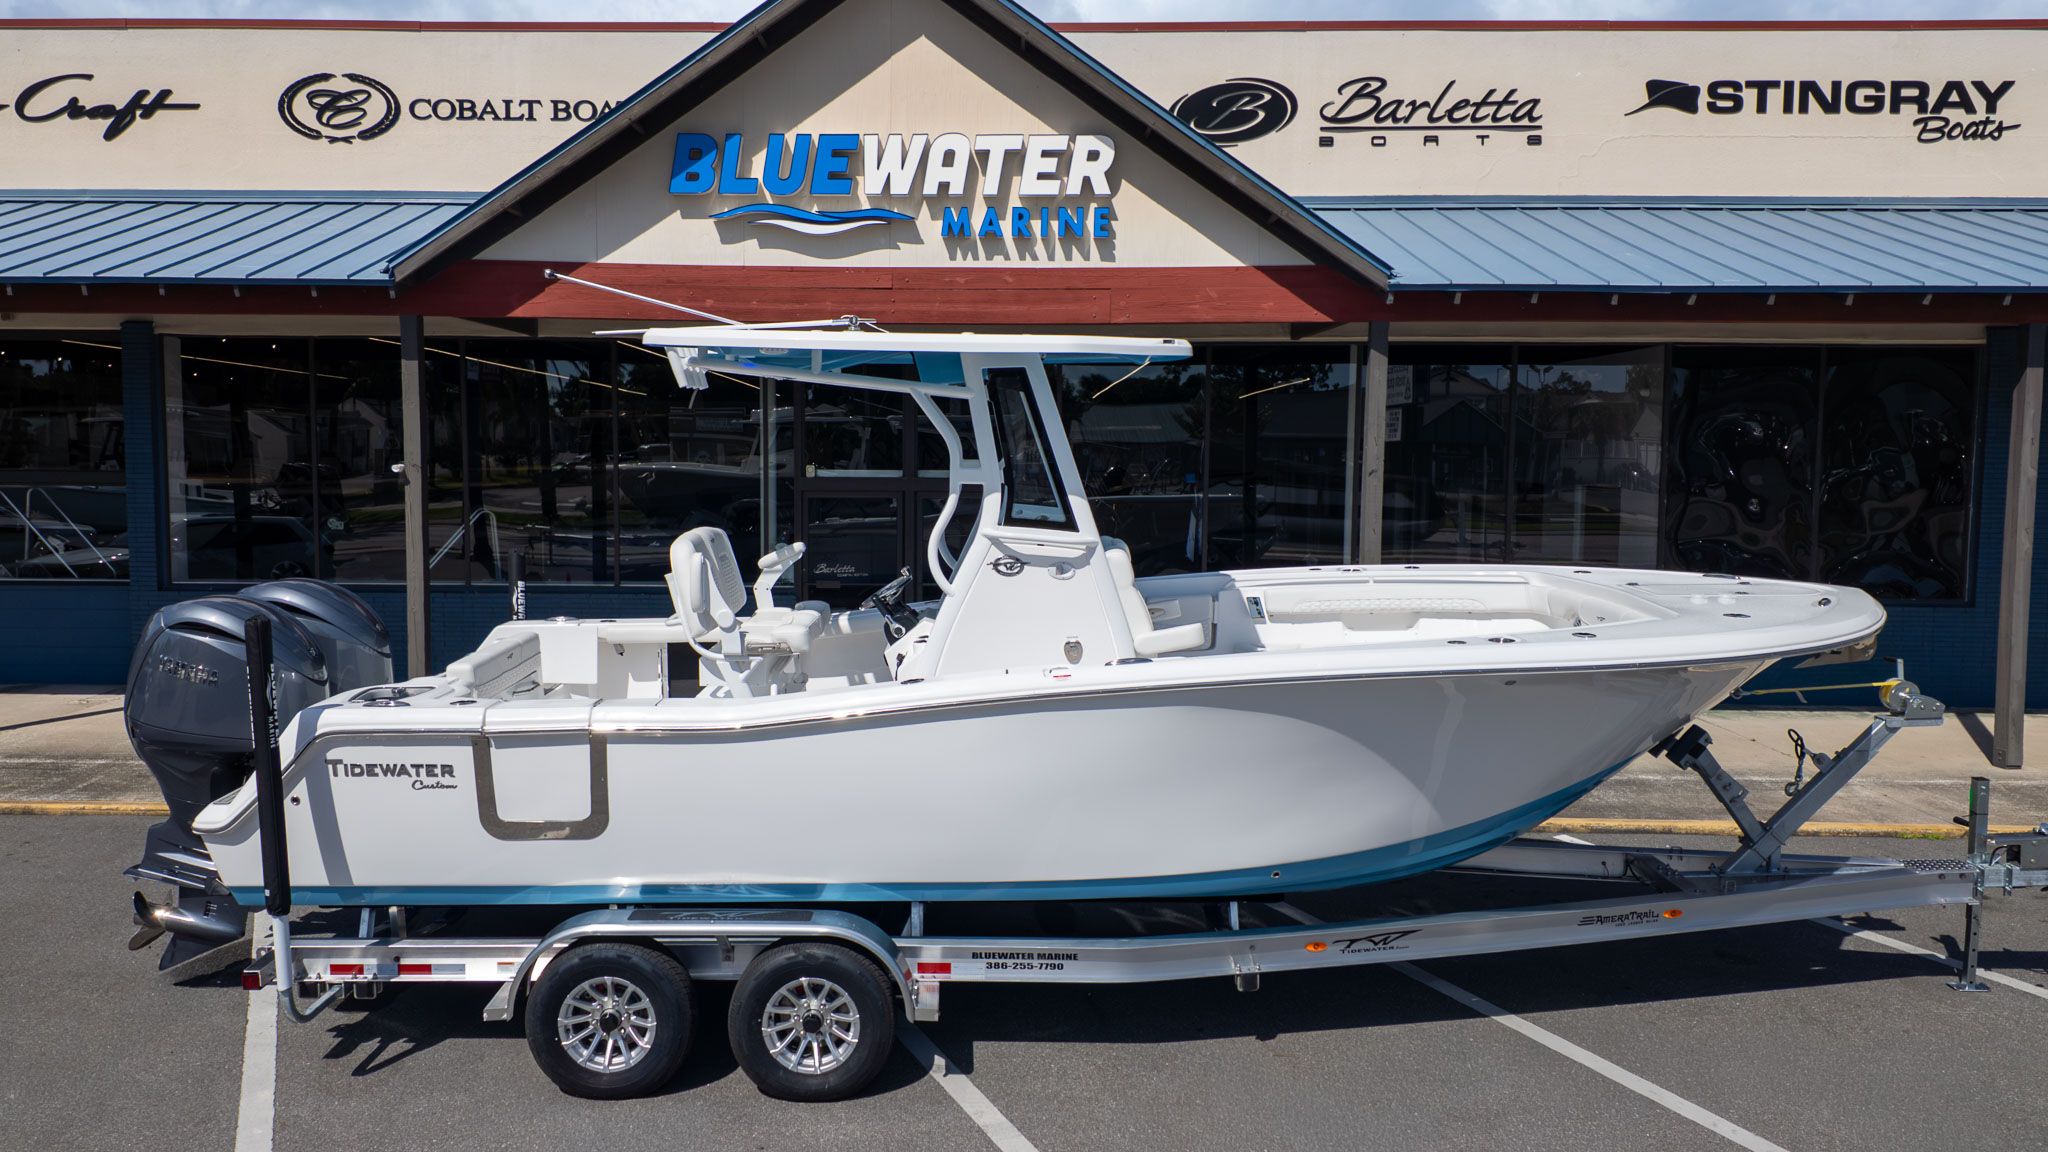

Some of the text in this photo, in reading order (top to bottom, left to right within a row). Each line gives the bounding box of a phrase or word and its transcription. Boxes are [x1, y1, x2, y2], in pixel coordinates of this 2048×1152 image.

[14, 73, 201, 142] Craft
[1319, 76, 1543, 124] Barletta
[1706, 80, 2016, 115] STINGRAY
[408, 98, 624, 122] COBALT BOA
[1318, 134, 1543, 147] BOATS
[1913, 115, 2022, 144] Boats
[668, 132, 1118, 197] BLUEWATER
[941, 206, 1111, 238] MARINE
[813, 563, 856, 574] Barletta
[517, 580, 526, 620] BLUEWA
[325, 758, 456, 778] TIDEWATER
[411, 779, 458, 791] Custom
[971, 951, 1079, 960] BLUEWATER MARINE
[1339, 945, 1395, 954] TIDEWATER
[985, 962, 1064, 970] 386-255-7790
